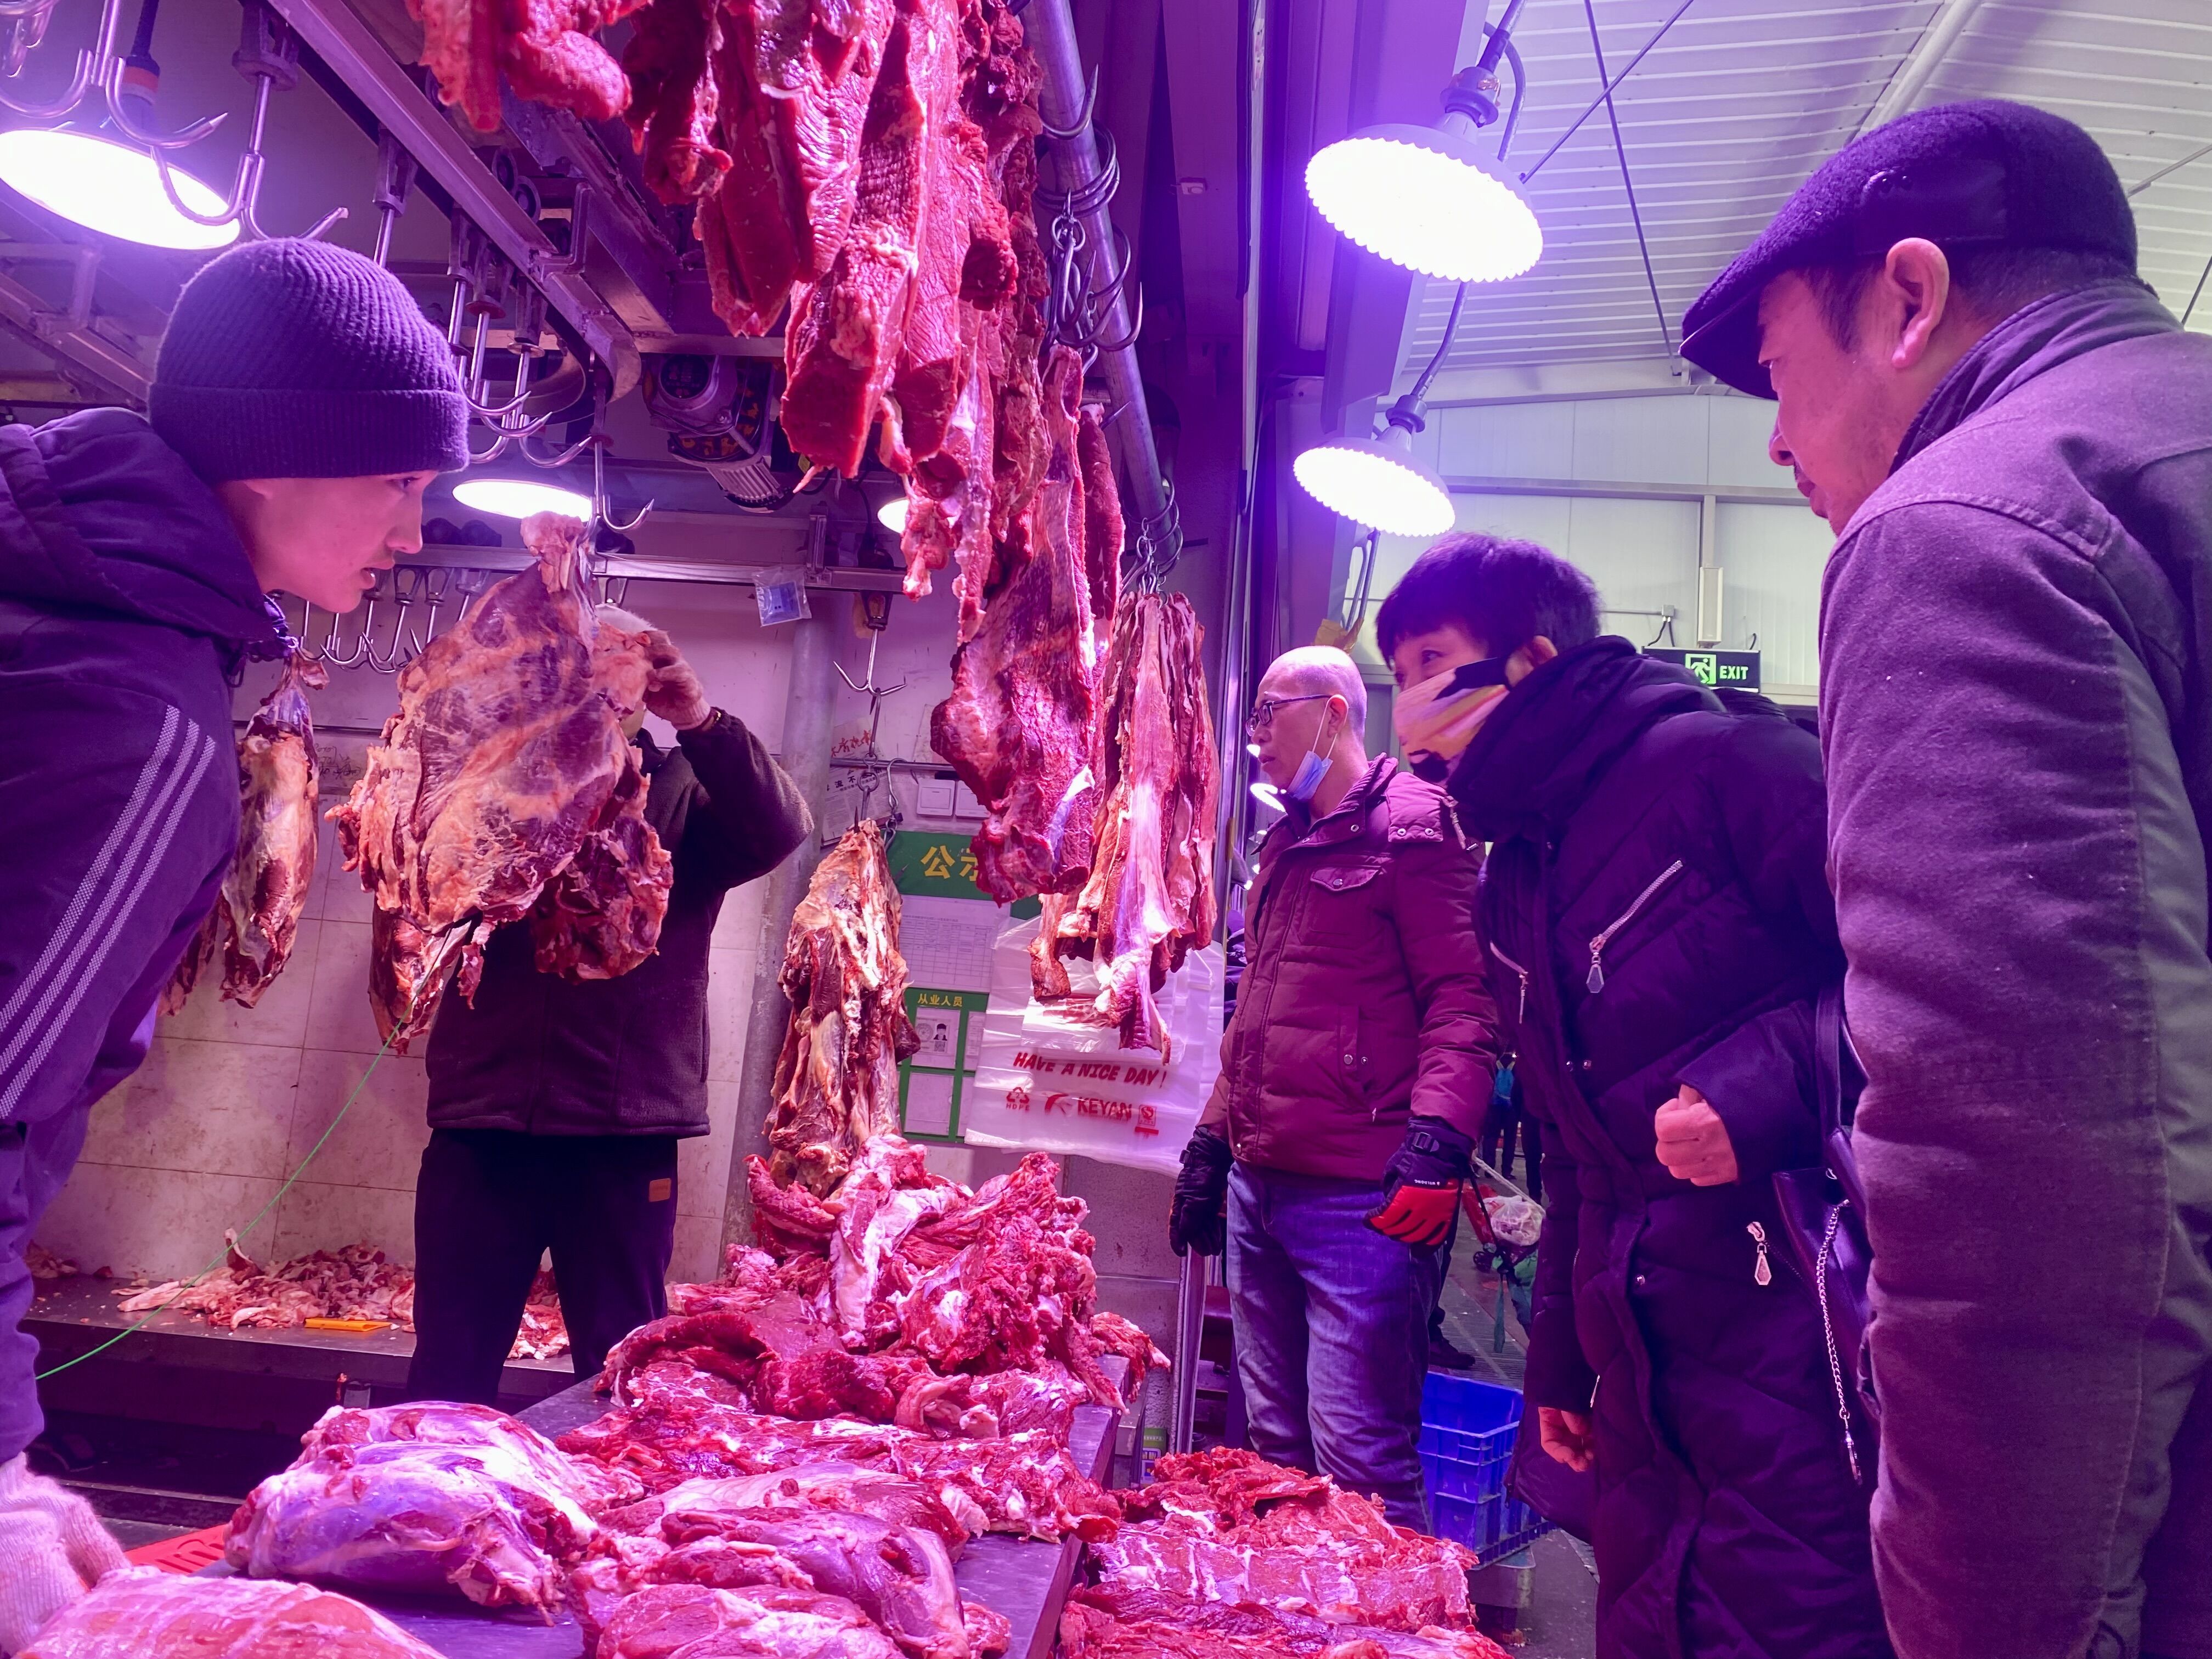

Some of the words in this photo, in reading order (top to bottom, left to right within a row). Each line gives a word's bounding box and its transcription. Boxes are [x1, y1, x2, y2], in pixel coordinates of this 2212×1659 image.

[1719, 665, 1749, 680] EXIT
[917, 993, 963, 1007] 从业人员
[1013, 1052, 1056, 1071] HAVE
[1061, 1063, 1075, 1075] A
[1077, 1063, 1121, 1081] NICE
[1006, 1103, 1030, 1111] HDPE
